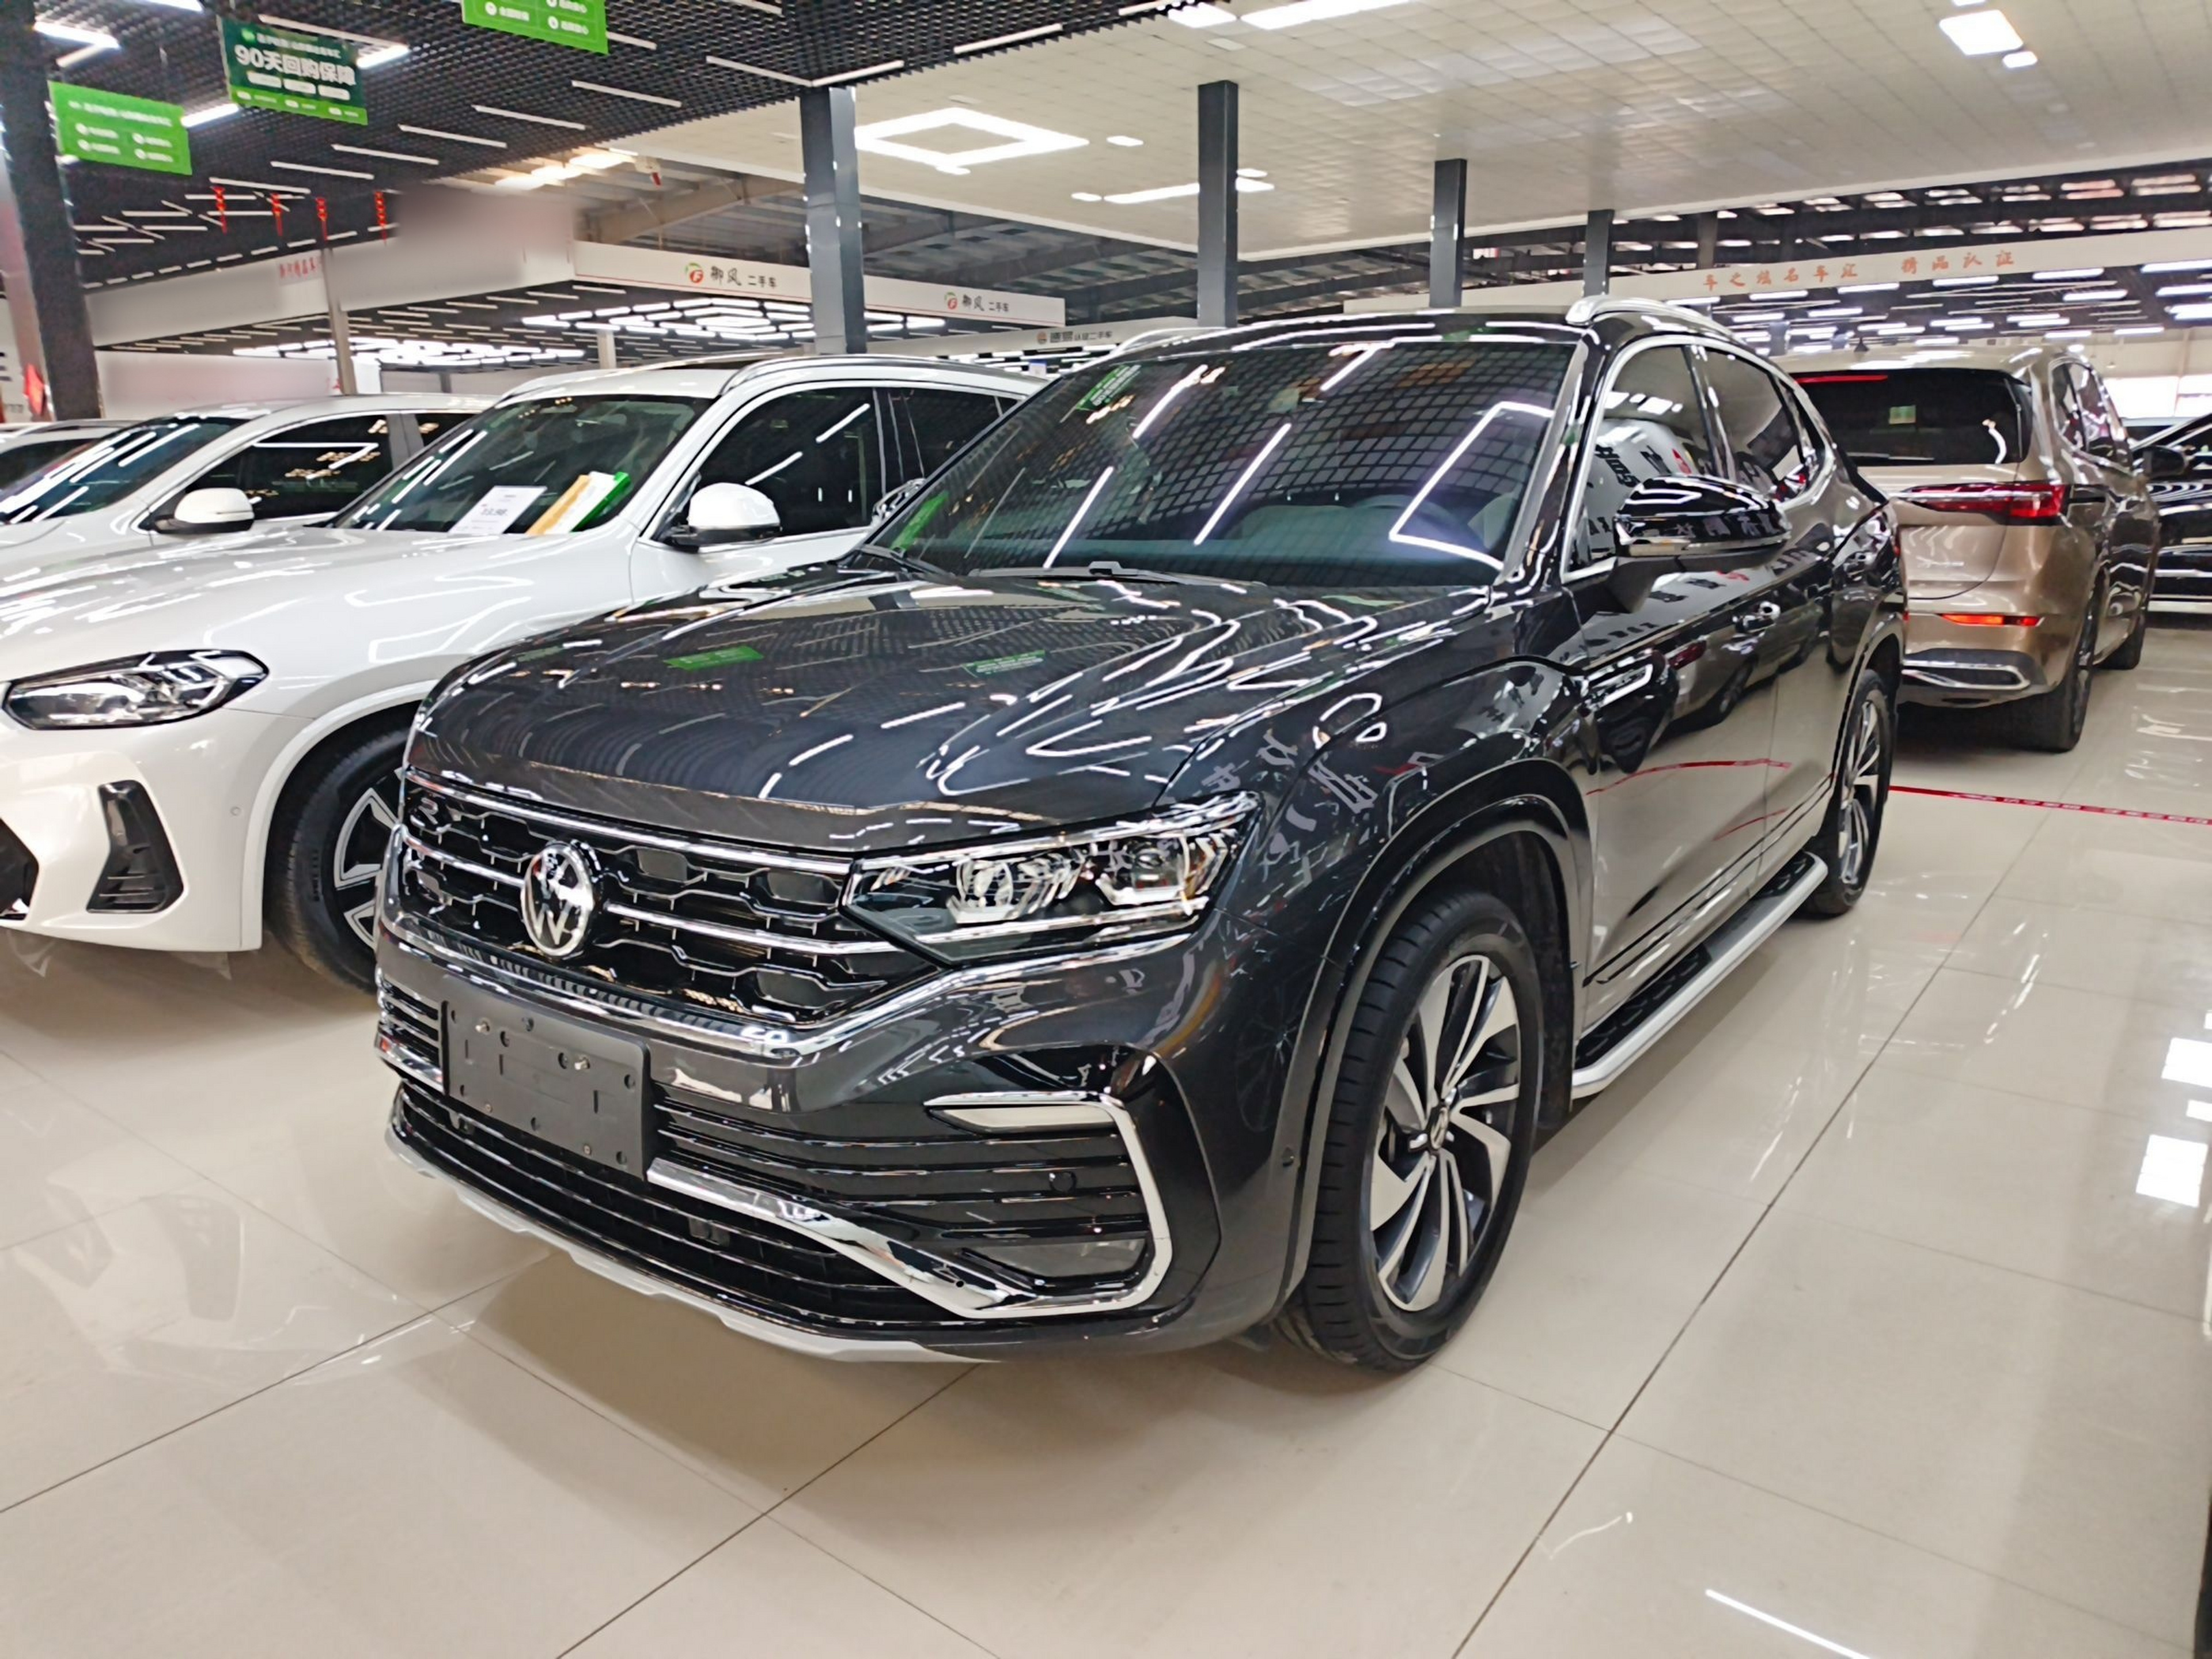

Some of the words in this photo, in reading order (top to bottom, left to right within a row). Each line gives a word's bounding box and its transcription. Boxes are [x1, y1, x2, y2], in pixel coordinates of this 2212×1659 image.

[234, 44, 356, 85] 90天回购保障
[748, 275, 777, 288] 二手车
